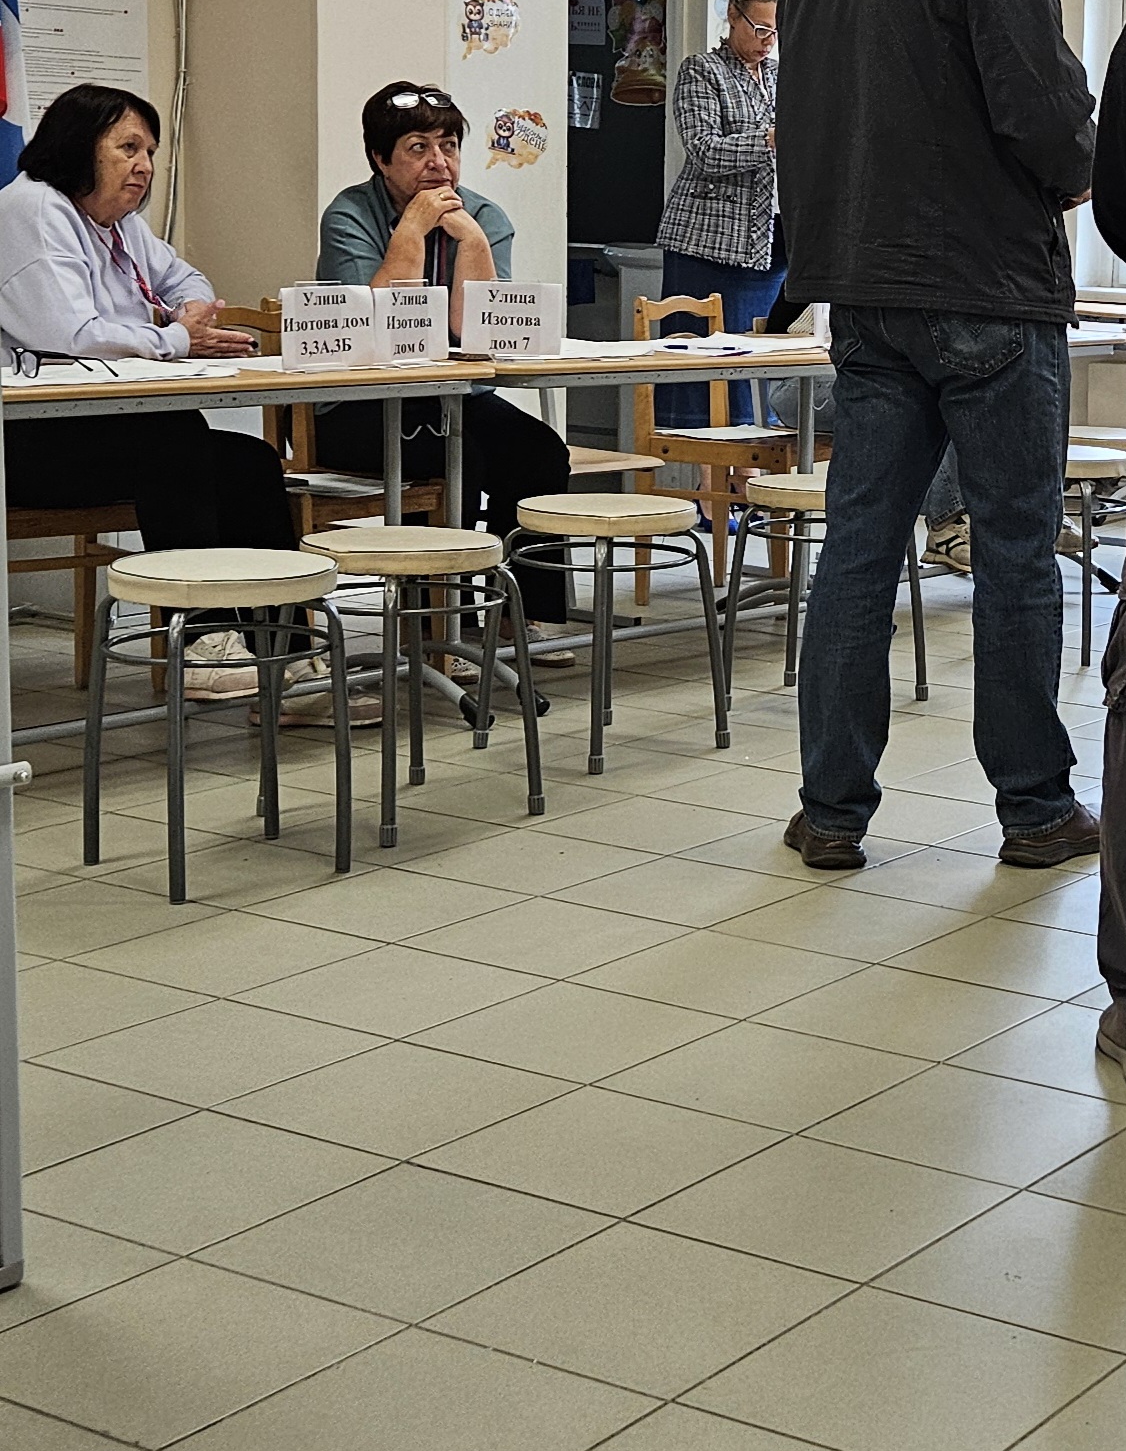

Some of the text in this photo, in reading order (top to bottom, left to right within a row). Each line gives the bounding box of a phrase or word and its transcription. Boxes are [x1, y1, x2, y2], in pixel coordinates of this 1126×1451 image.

[303, 291, 347, 307] Улица
[391, 291, 428, 307] Улица
[488, 289, 536, 305] Улица
[283, 316, 370, 333] Изотова дом
[386, 315, 432, 330] Изотова
[481, 311, 541, 327] Изотова
[300, 338, 352, 358] 3,3А,3Б
[393, 338, 426, 355] дом 6
[488, 336, 530, 350] дом 7
